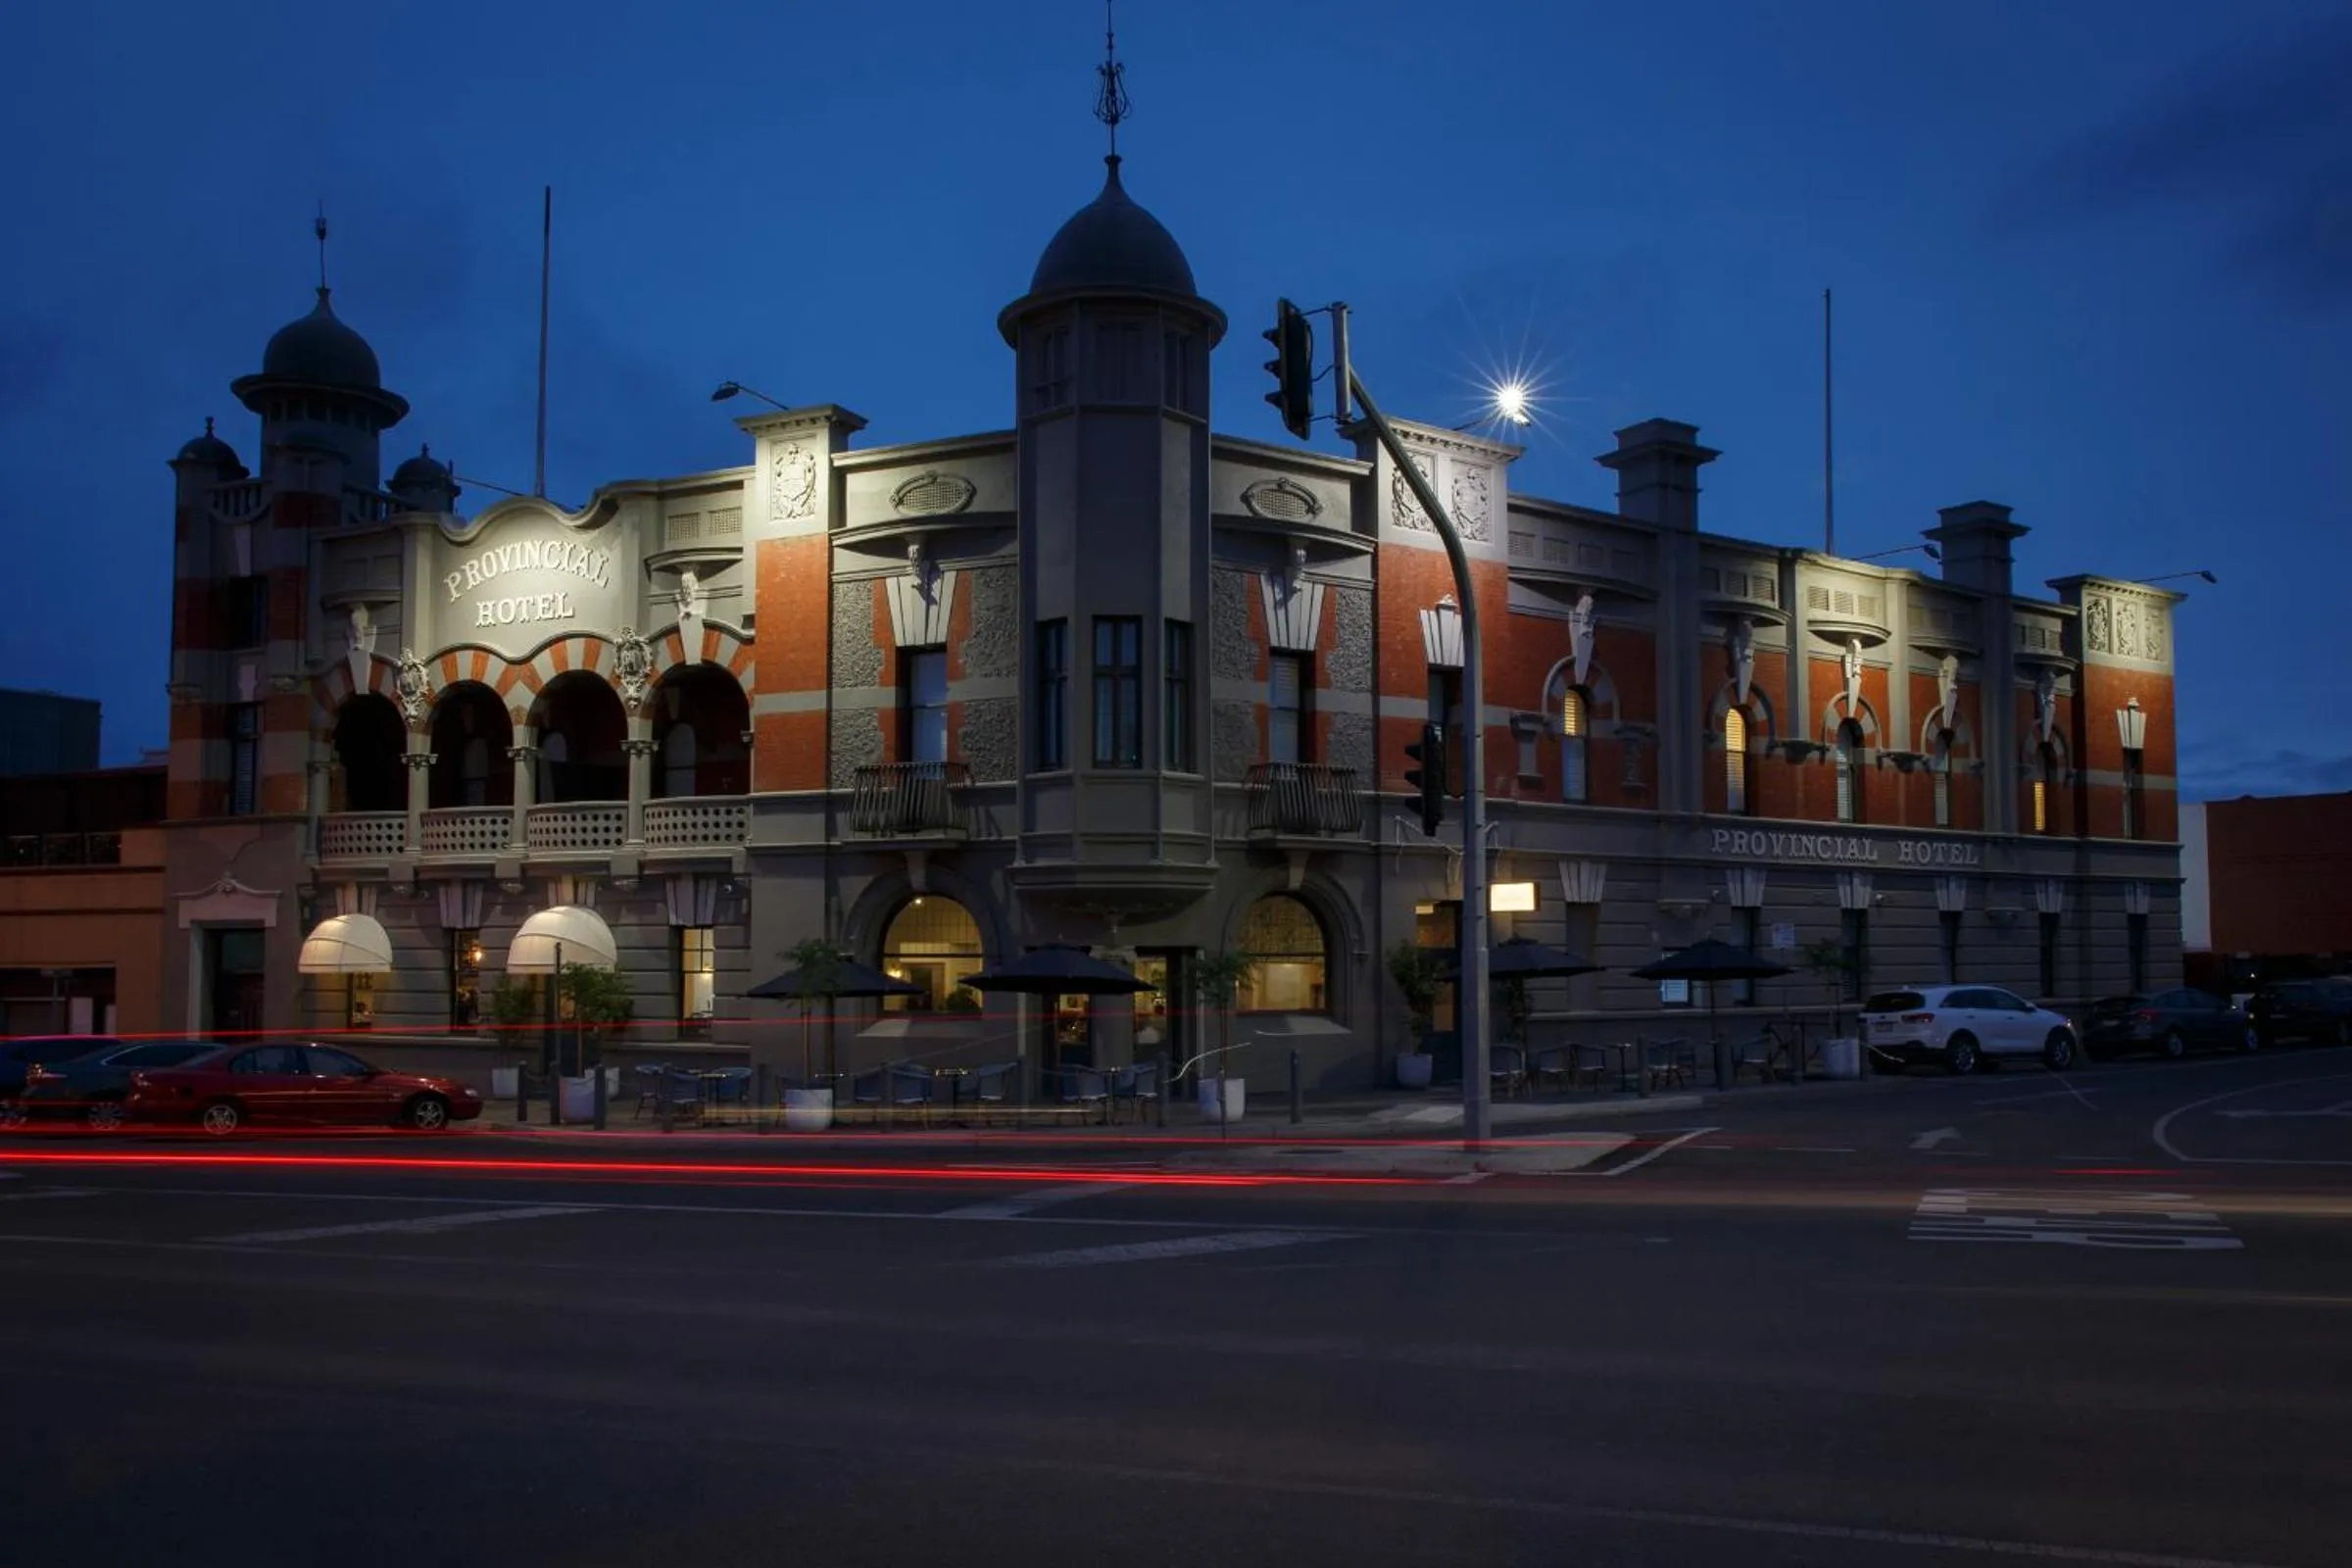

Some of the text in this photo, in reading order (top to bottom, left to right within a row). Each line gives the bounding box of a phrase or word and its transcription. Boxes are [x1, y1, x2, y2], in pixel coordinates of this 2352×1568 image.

[444, 540, 610, 603] PROVINCIAL
[476, 591, 575, 627] HOTEL
[1711, 828, 1980, 865] PROVINCIAL HOTEL
